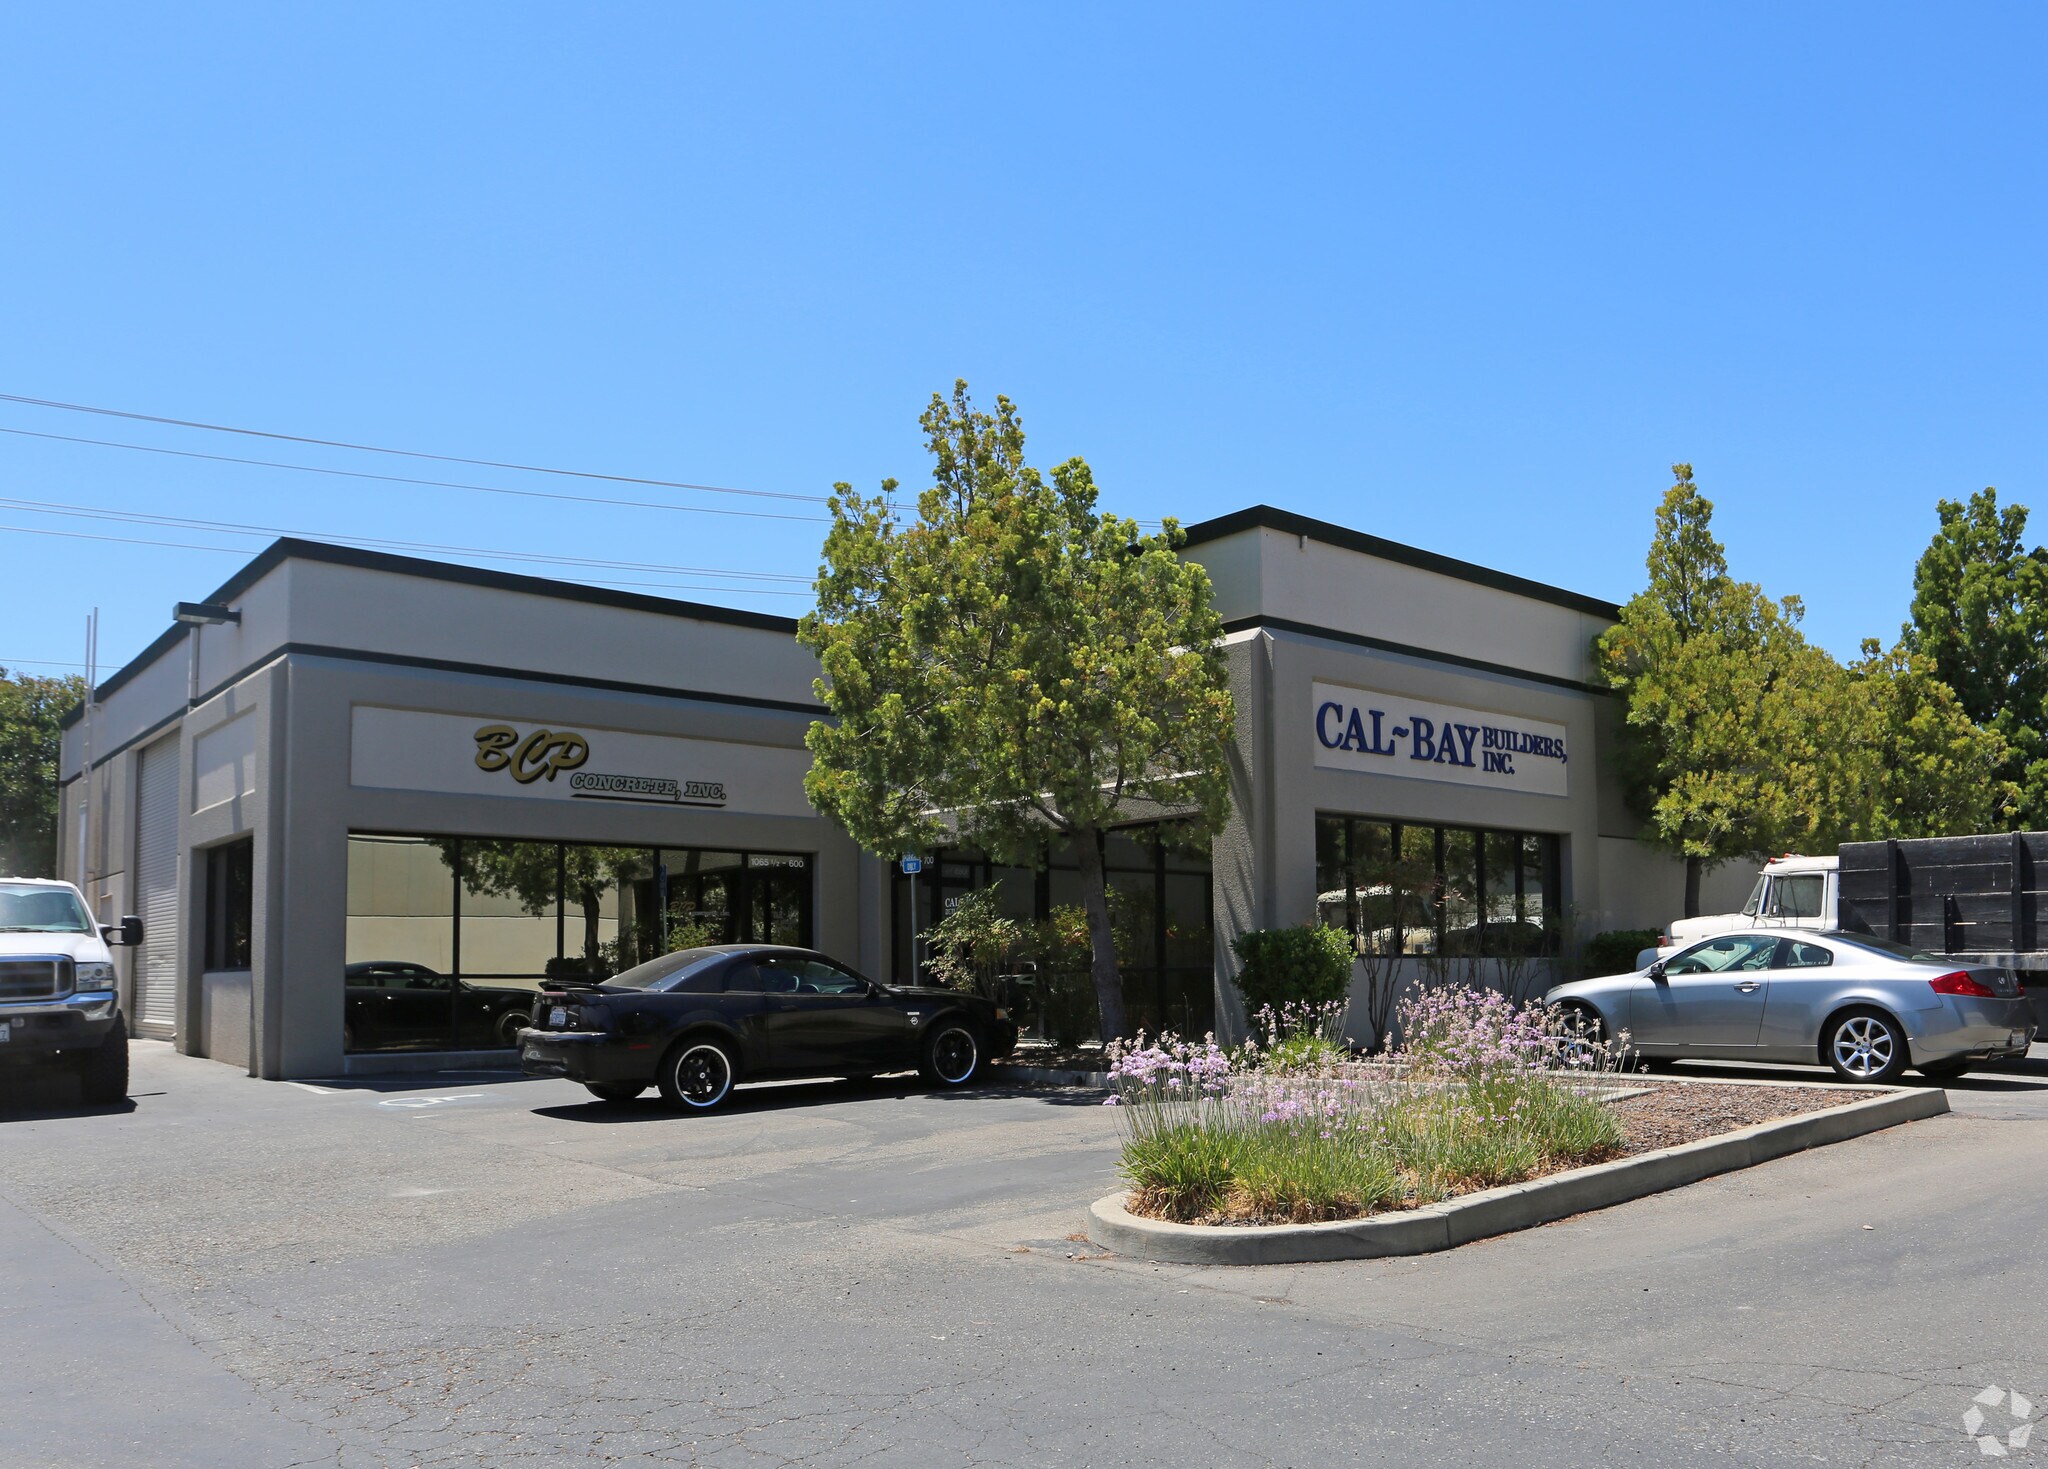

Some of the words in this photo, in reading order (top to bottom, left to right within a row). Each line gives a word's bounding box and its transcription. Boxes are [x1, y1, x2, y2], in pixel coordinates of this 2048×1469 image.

[473, 724, 589, 784] BCP
[1482, 726, 1568, 763] BUILDERS,
[1482, 751, 1515, 775] INC.
[570, 772, 681, 800] CONCRETE,
[684, 781, 727, 800] INC.
[751, 857, 769, 866] 1065
[788, 860, 804, 868] 600
